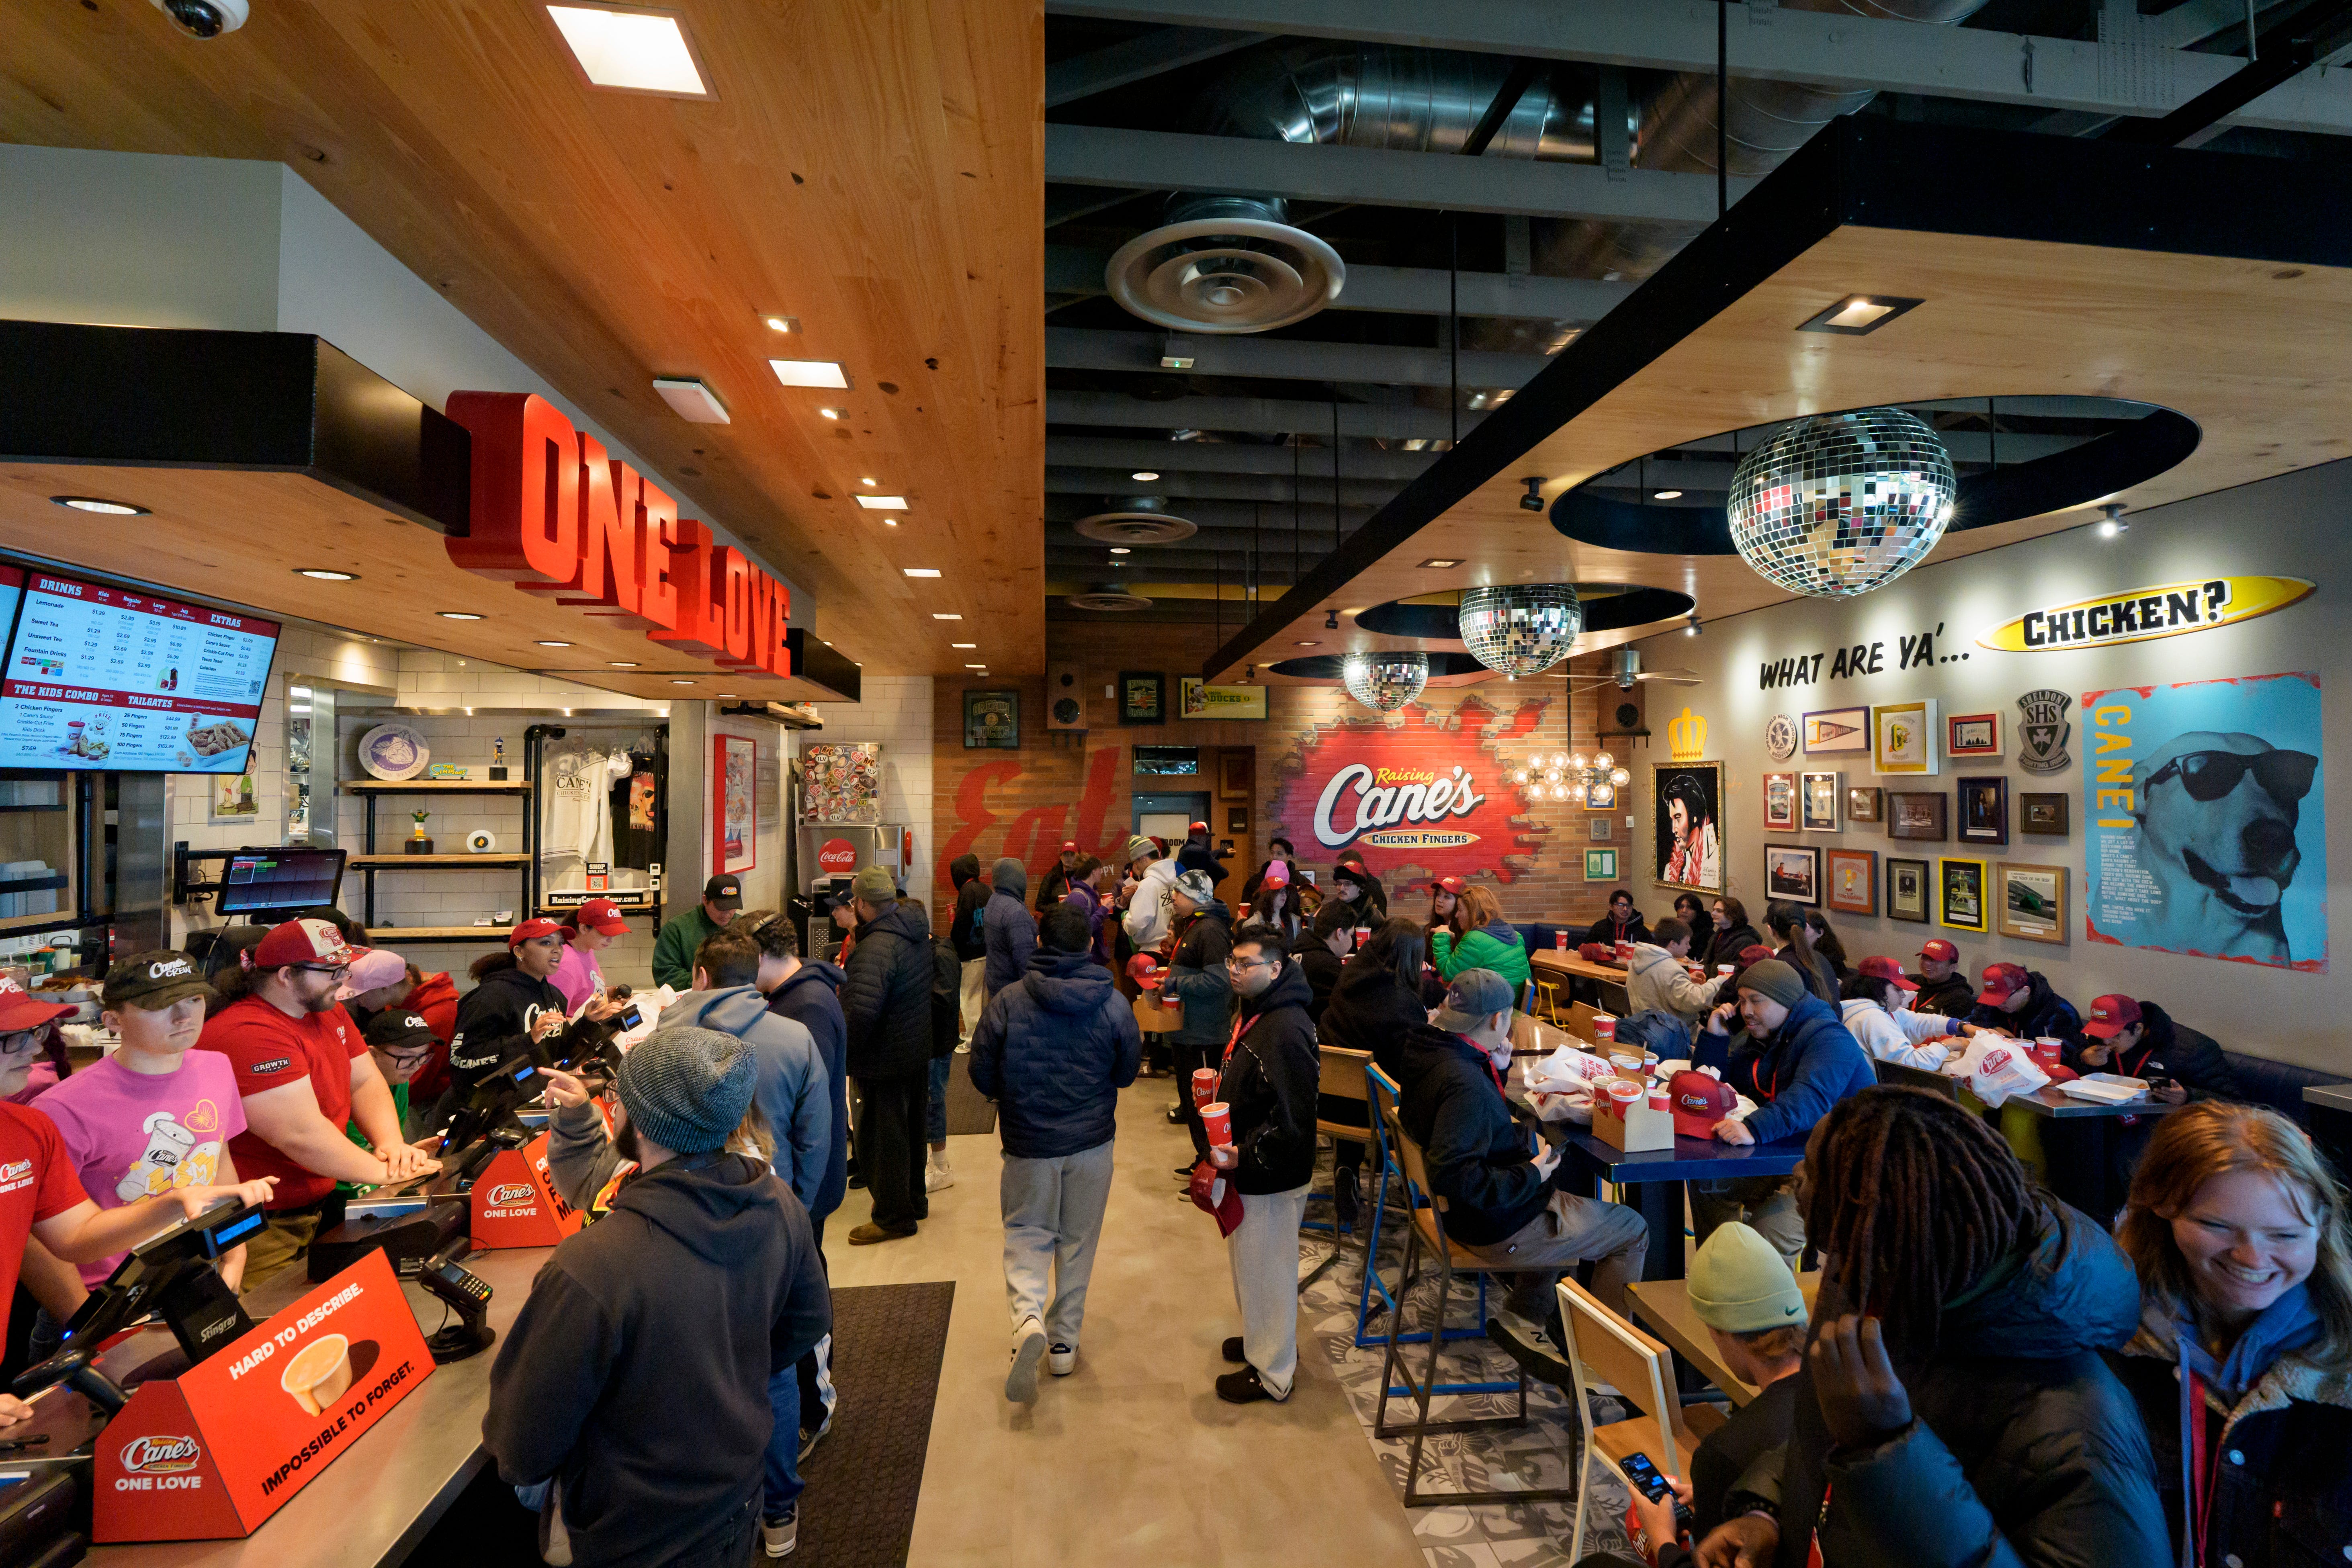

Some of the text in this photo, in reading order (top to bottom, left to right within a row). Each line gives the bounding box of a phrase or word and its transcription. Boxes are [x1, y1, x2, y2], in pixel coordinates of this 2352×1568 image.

[522, 393, 790, 680] ONE LOVE
[39, 579, 82, 596] DRINKS
[36, 599, 63, 608] Lemonade
[123, 596, 141, 604] Regular
[211, 614, 241, 627] EXTRAS
[2023, 580, 2229, 648] CHICKEN?
[1760, 652, 1824, 690] WHAT
[1830, 642, 1885, 679] ARE
[14, 684, 98, 701] THE KIDS COMBO
[2022, 691, 2063, 706] SHELDON
[128, 696, 173, 708] TAILGATES
[973, 700, 1009, 715] OREGON
[2027, 704, 2057, 724] SHS
[973, 726, 1009, 738] DUCKS
[2050, 753, 2065, 767] IRISH
[2095, 704, 2134, 810] CANE
[366, 761, 381, 774] LABOR
[397, 763, 420, 777] WEEKEND
[1376, 768, 1434, 785] Raising
[1313, 764, 1486, 850] Cane's
[936, 746, 1130, 898] Eat
[1372, 833, 1468, 845] CHICKEN FINGERS
[820, 851, 855, 863] Coca-Cola
[148, 958, 187, 979] Cane's
[165, 966, 192, 977] CREW
[1595, 1029, 1612, 1038] Cane's
[254, 1060, 289, 1071] GROWTH
[1980, 1048, 2008, 1077] Cane's
[1681, 1094, 1708, 1105] Cane's
[148, 1149, 178, 1163] Cane's
[0, 1159, 32, 1183] Cane's
[0, 1177, 35, 1193] ONE LOVE
[490, 1183, 534, 1206] Cane's
[484, 1208, 536, 1218] ONE LOVE
[201, 1313, 236, 1343] Stingray
[229, 1283, 364, 1380] HARD TO DESCRIBE.
[261, 1362, 415, 1496] IMPOSSIBLE TO FORGET.
[125, 1436, 199, 1470] Cane's
[115, 1476, 201, 1491] ONE LOVE
